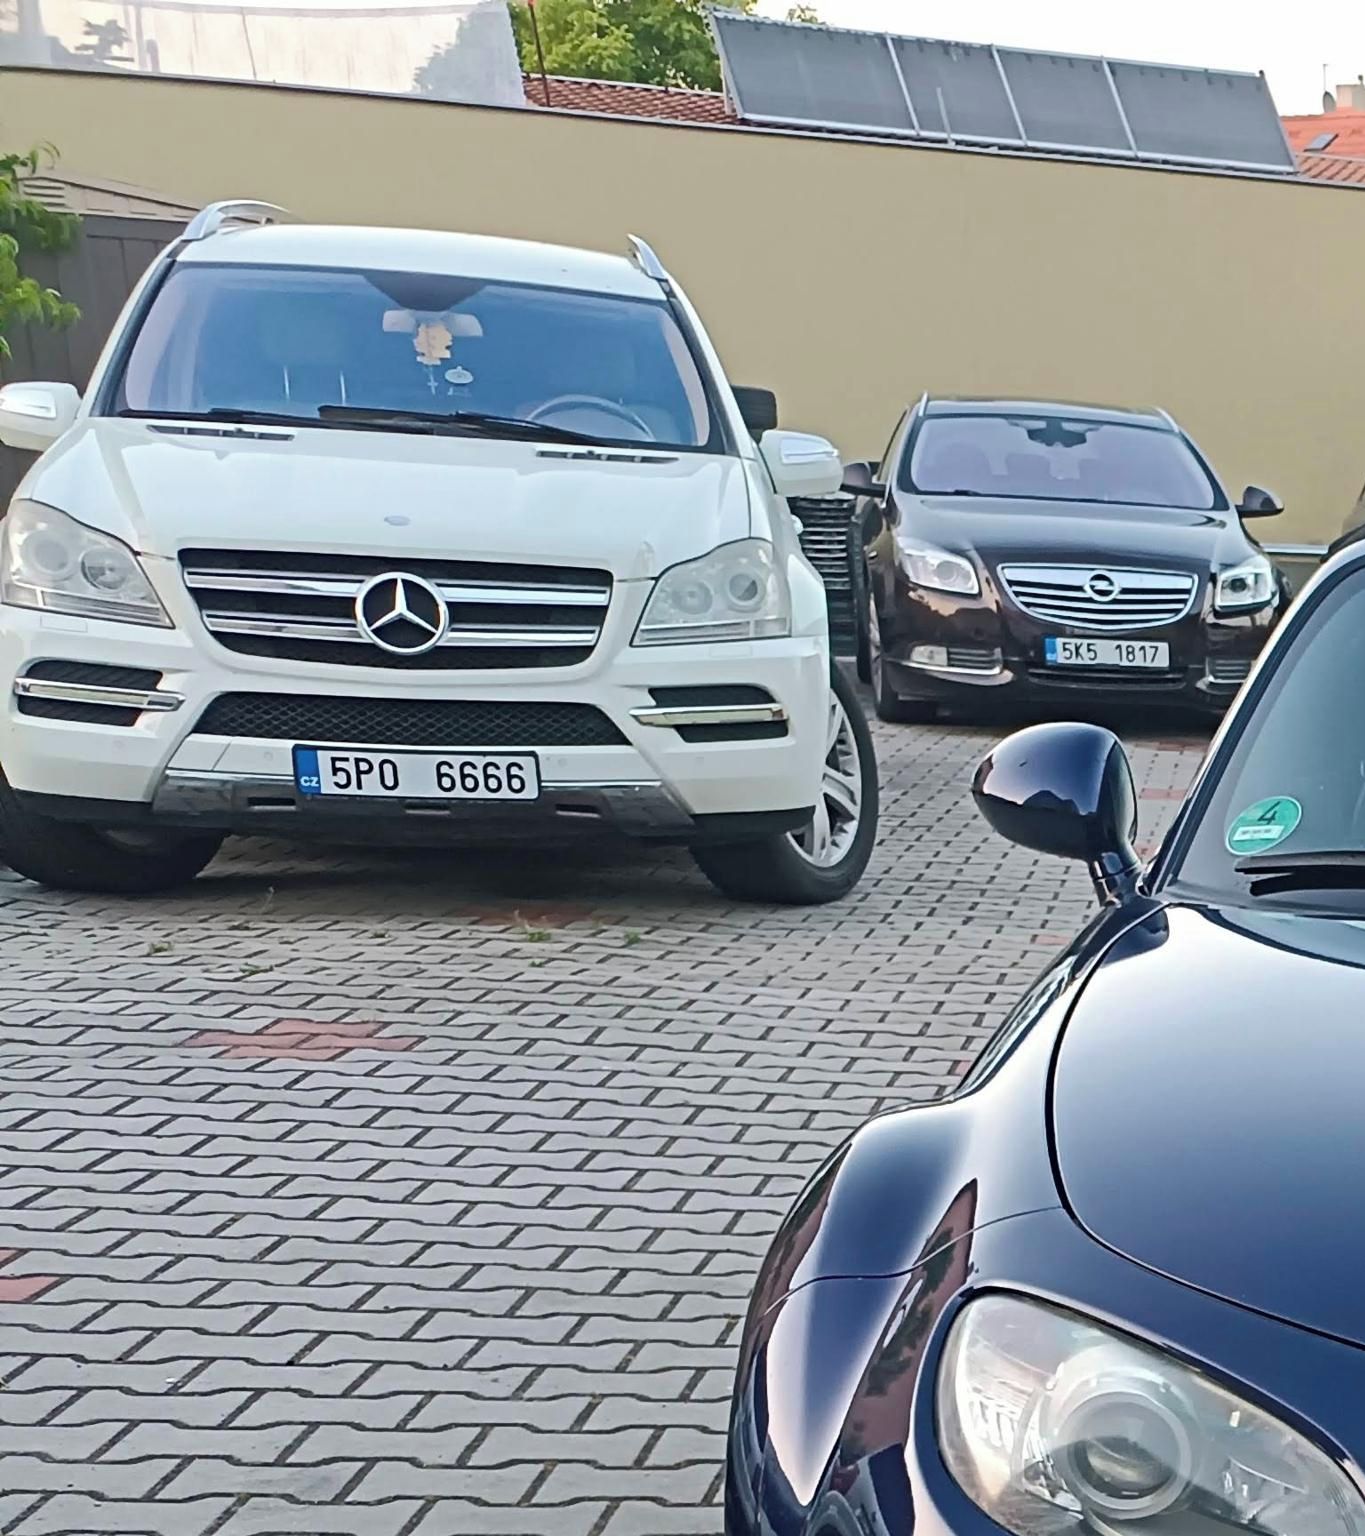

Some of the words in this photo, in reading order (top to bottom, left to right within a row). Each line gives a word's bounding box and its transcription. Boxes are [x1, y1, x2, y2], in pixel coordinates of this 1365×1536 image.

[1062, 642, 1097, 661] 5K5
[1115, 644, 1159, 663] 1817
[300, 775, 319, 787] CZ
[436, 760, 526, 794] 6666
